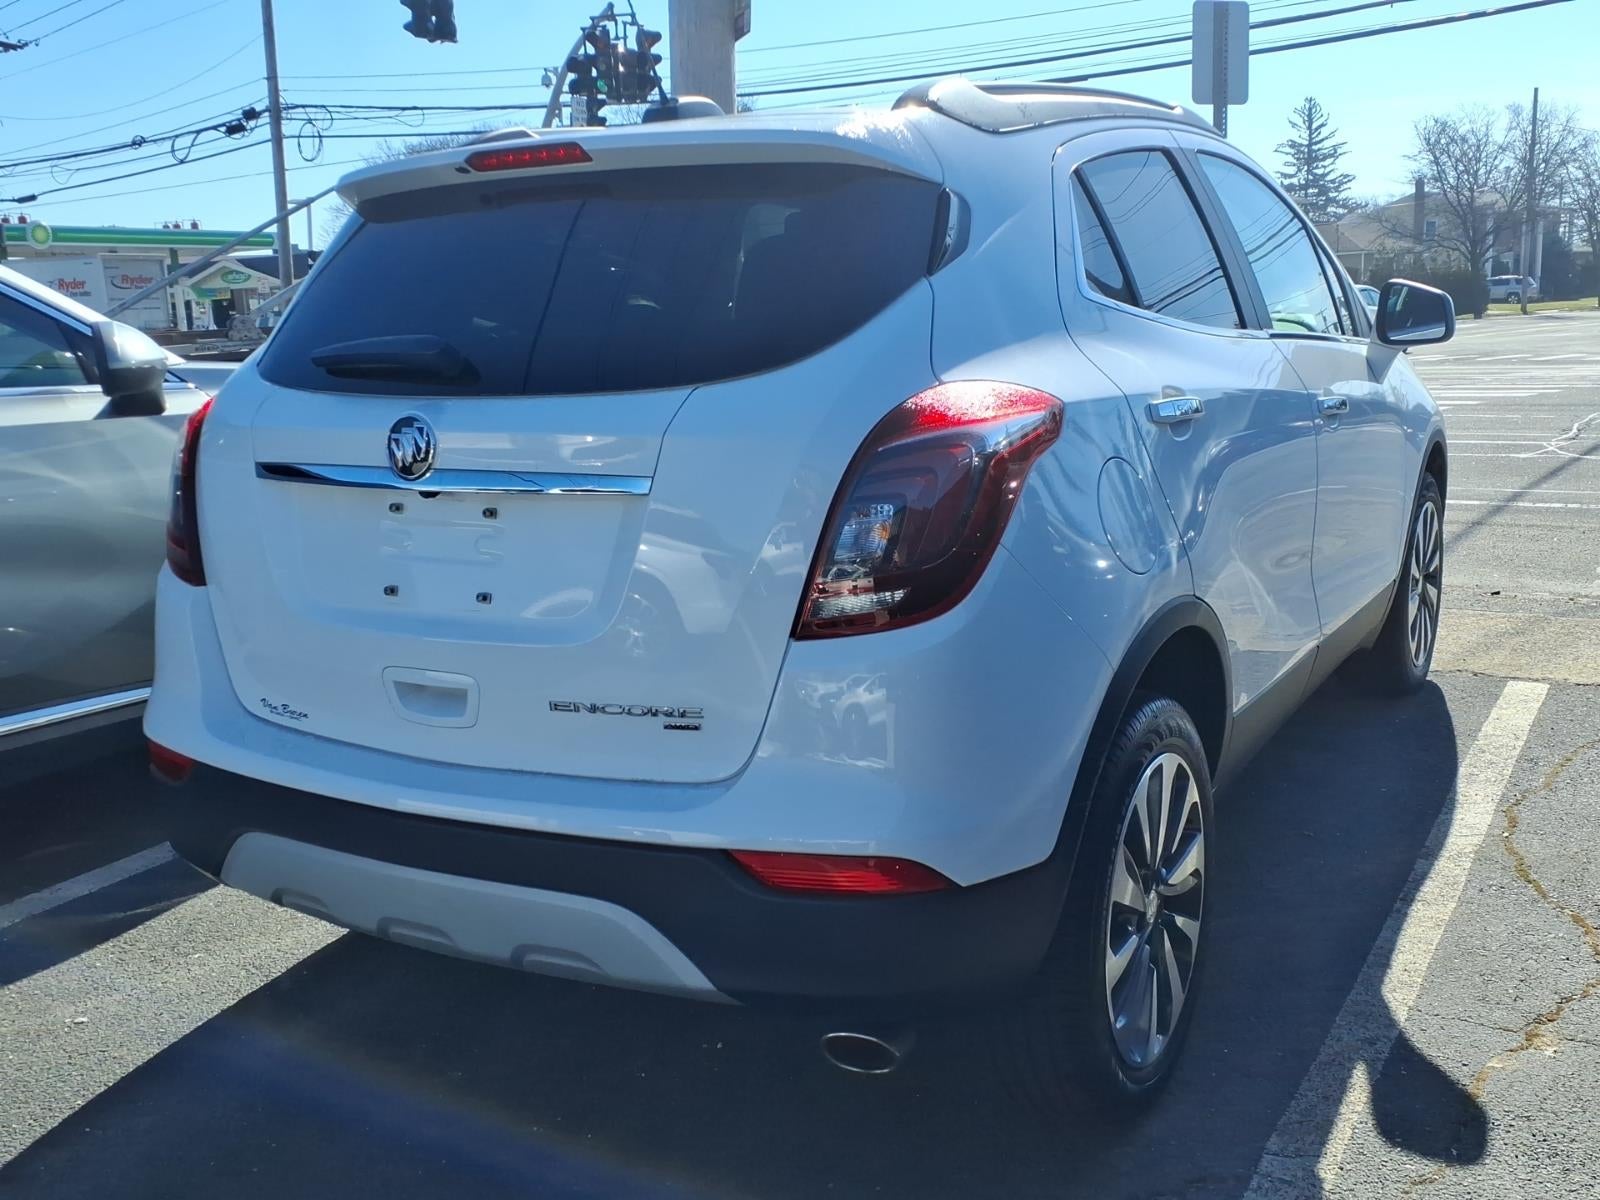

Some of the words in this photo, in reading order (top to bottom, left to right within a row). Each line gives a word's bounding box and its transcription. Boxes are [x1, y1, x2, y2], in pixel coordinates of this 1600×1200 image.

[58, 277, 86, 292] Ryder
[121, 274, 153, 287] Ryder
[549, 700, 704, 718] ENCORE
